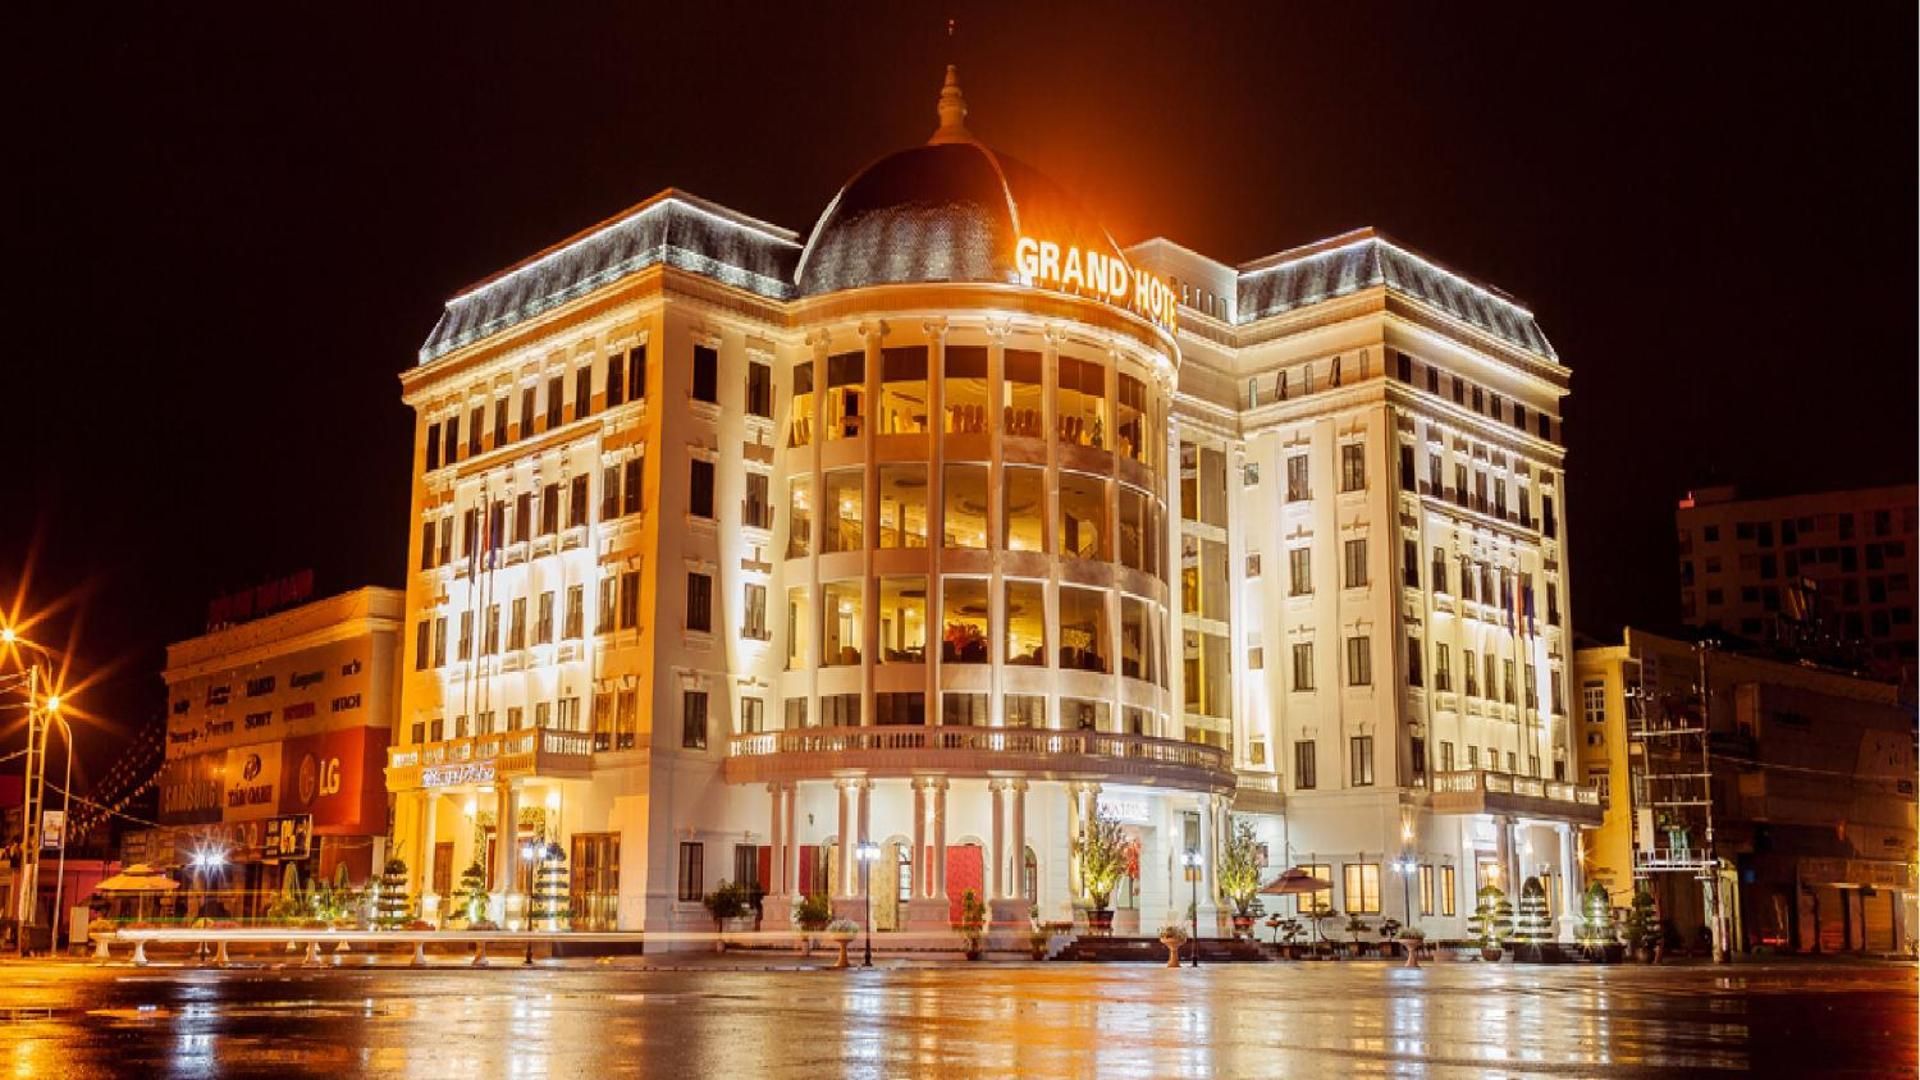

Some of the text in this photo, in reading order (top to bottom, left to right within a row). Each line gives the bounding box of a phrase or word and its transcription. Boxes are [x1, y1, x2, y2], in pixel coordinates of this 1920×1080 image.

[1016, 236, 1128, 297] GRAND
[165, 780, 217, 813] SAMSUNG
[319, 757, 341, 797] LG
